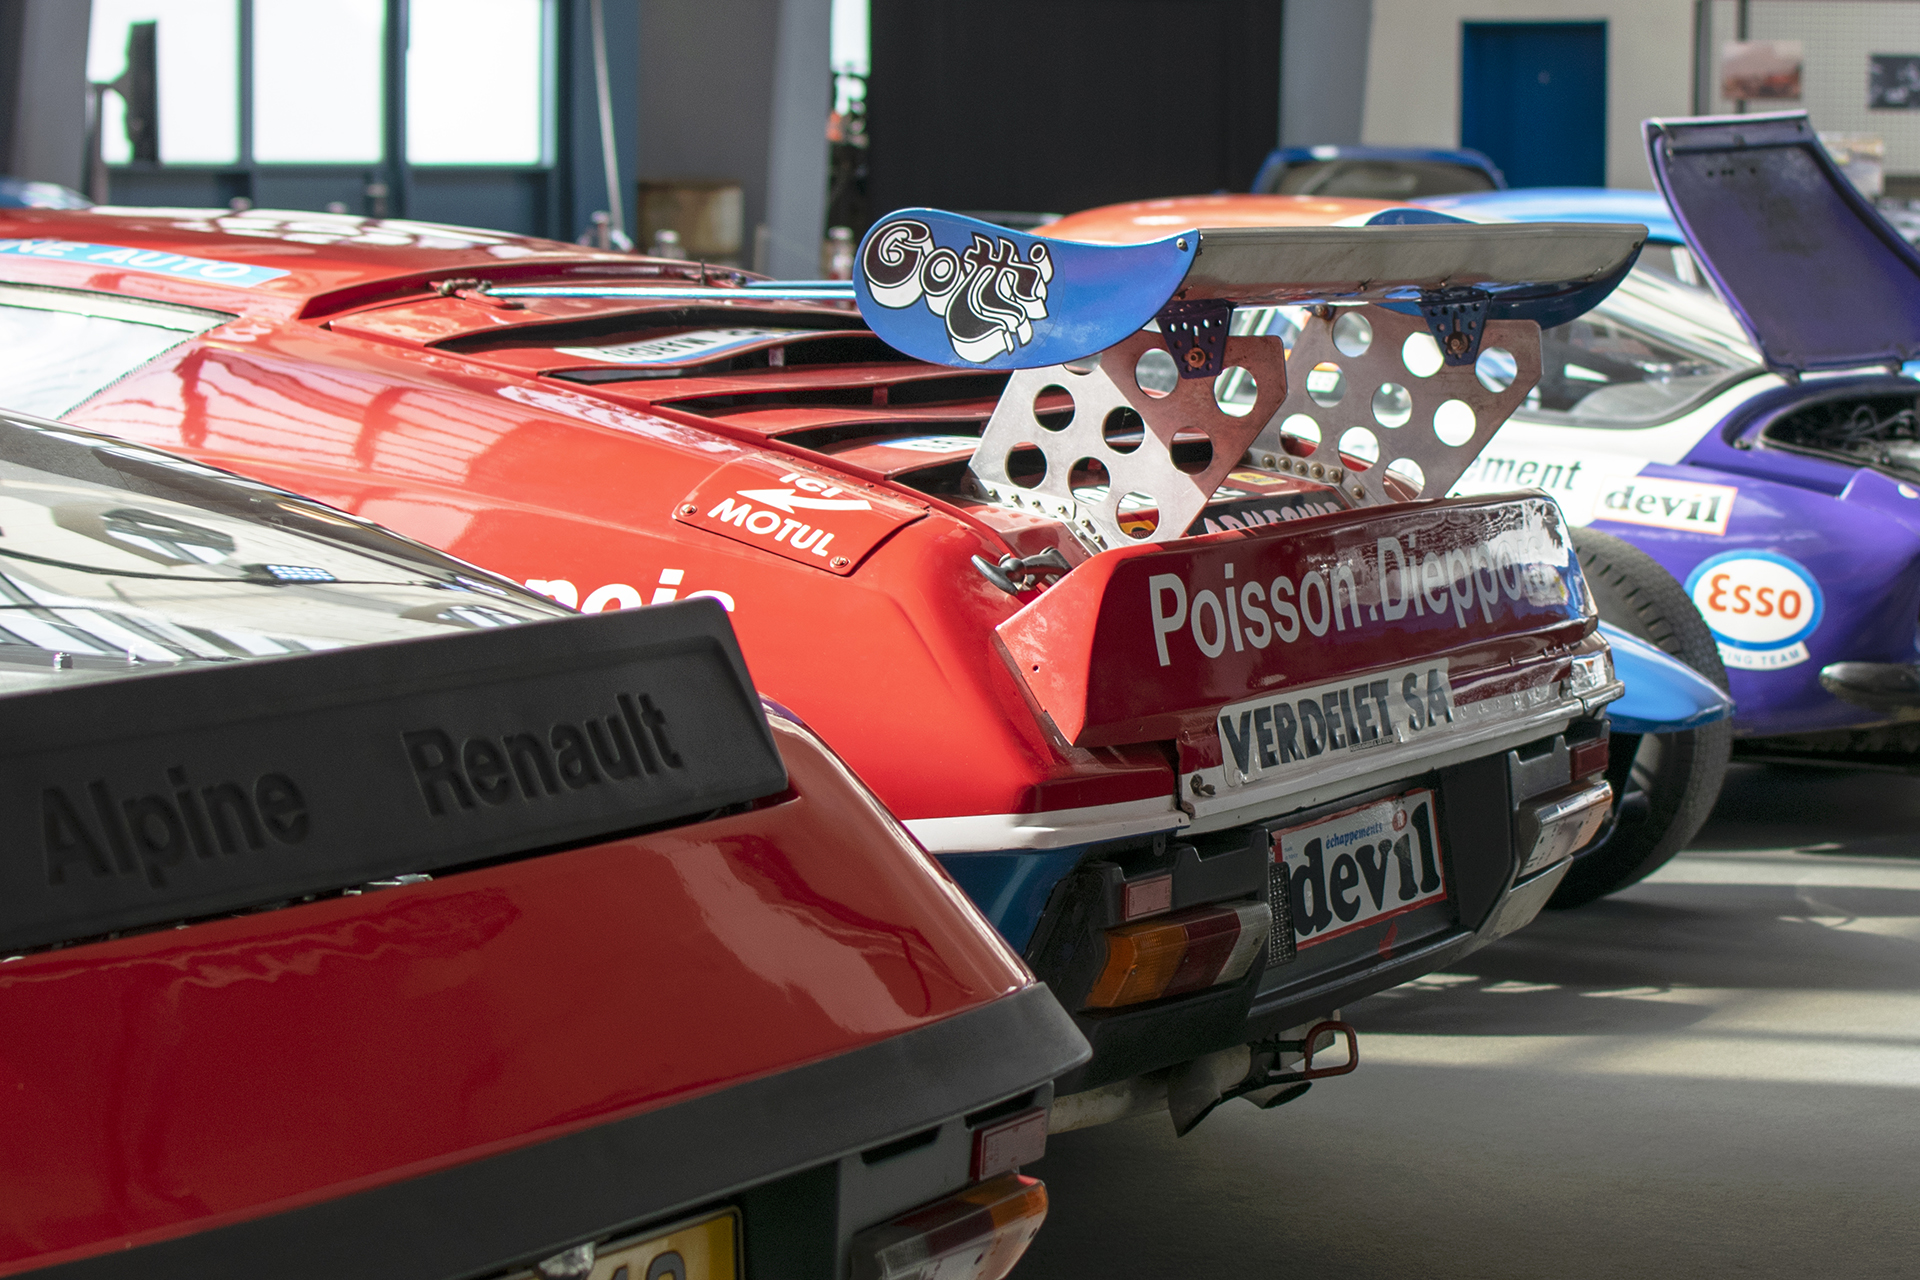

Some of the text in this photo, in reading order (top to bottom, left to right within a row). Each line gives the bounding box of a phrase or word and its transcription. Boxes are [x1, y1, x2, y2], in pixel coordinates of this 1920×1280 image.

[87, 249, 252, 278] AUTO
[861, 218, 1054, 364] Gotti
[779, 472, 843, 498] ICI
[1604, 486, 1722, 523] devil
[707, 498, 835, 557] MOTUL
[1761, 649, 1800, 665] TEAM
[1220, 678, 1394, 775] VERDELET
[1401, 668, 1454, 732] SA
[41, 693, 684, 889] Alpine Renault
[1325, 822, 1383, 850] échappements
[1290, 801, 1441, 936] devil
